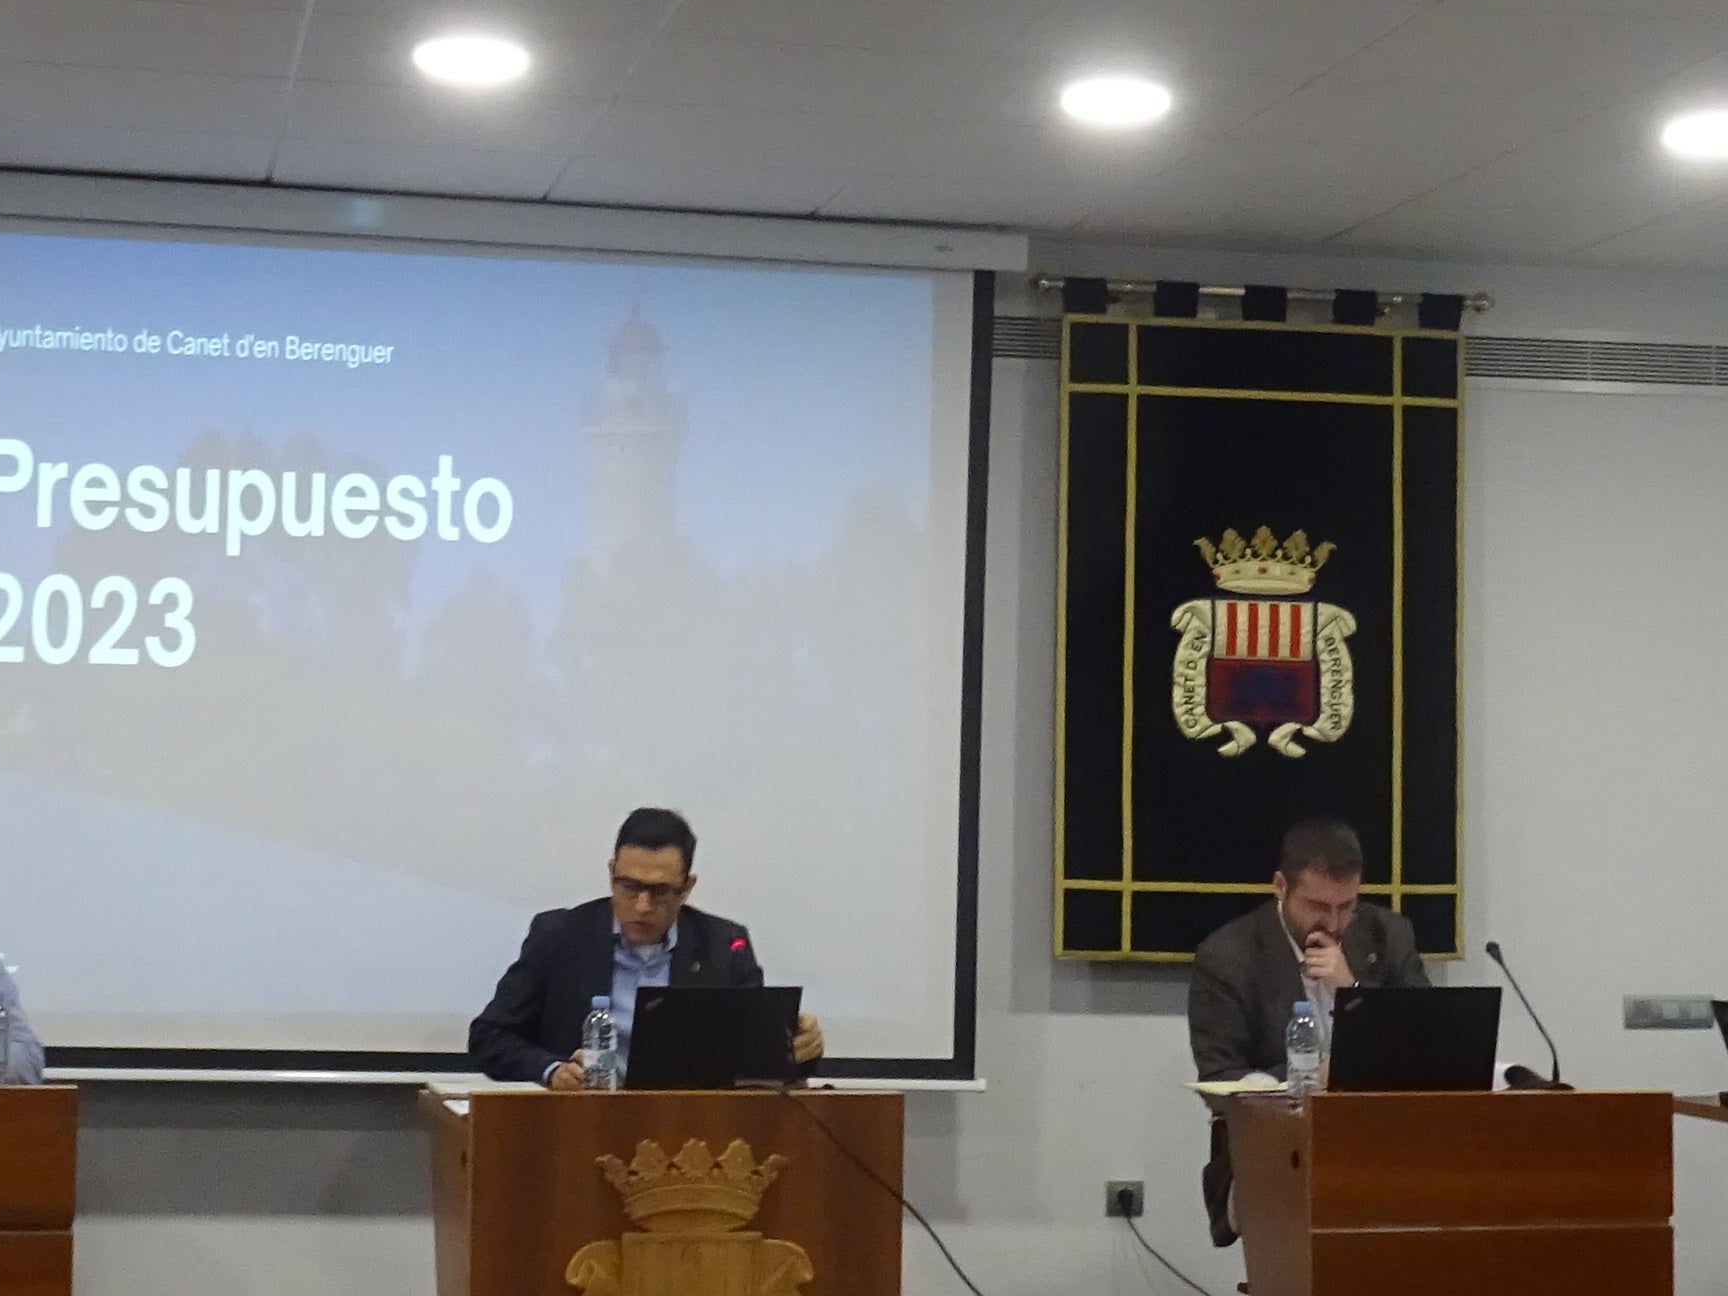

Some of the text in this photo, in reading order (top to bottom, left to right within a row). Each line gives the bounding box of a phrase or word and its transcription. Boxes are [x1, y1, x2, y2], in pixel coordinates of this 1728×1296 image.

[132, 328, 162, 354] de
[167, 330, 230, 356] Canet
[235, 333, 280, 359] d'en
[285, 335, 395, 368] Berenguer
[1182, 675, 1198, 729] CANET
